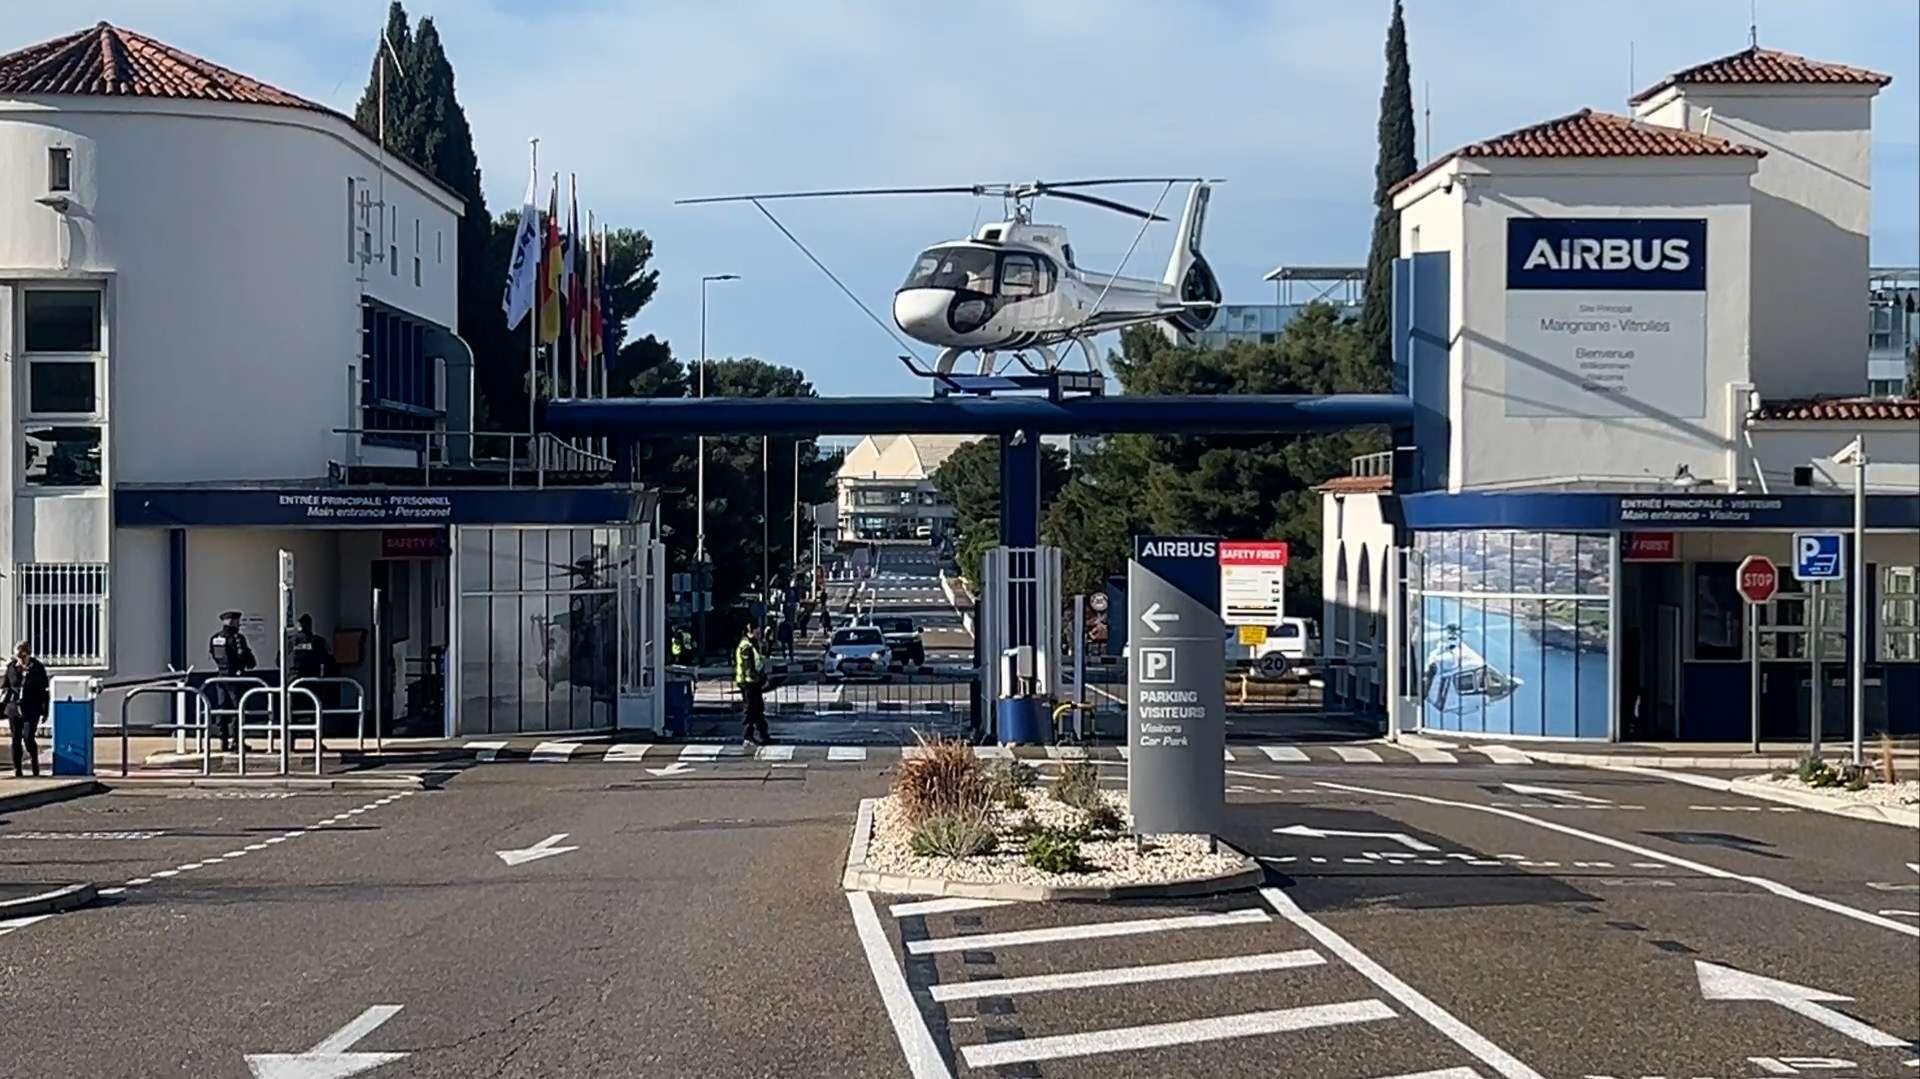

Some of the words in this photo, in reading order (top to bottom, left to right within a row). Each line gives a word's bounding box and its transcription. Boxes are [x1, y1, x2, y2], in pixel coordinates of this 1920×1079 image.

[1522, 238, 1691, 271] AIRBUS
[1541, 318, 1610, 335] Marignane
[1618, 318, 1670, 332] Vitrolles
[1576, 347, 1635, 359] Bienvenue
[279, 495, 319, 506] ENTRÉE
[321, 496, 382, 506] PRINCIPALE
[390, 496, 451, 506] PERSONNEL
[1621, 498, 1662, 509] ENTRÉE
[1663, 500, 1724, 509] PRINCIPALE
[1731, 500, 1782, 509] VISITEURS
[307, 506, 335, 517] Main
[336, 507, 386, 517] entrance
[395, 506, 451, 517] Personnel
[1621, 509, 1649, 520] Main
[1650, 510, 1700, 520] entrance
[1709, 509, 1750, 520] Visitors
[1142, 541, 1216, 558] AIRBUS
[1221, 549, 1255, 560] SAFETY
[1255, 549, 1281, 560] FIRST
[1800, 538, 1821, 565] P
[1744, 573, 1773, 587] STOP
[1147, 653, 1167, 678] P
[1263, 658, 1284, 671] 20
[1140, 690, 1198, 702] PARKING
[1139, 706, 1206, 718] VISITEURS
[1140, 722, 1182, 733] Visitors
[1140, 735, 1160, 746] Car
[1162, 735, 1188, 746] Park
